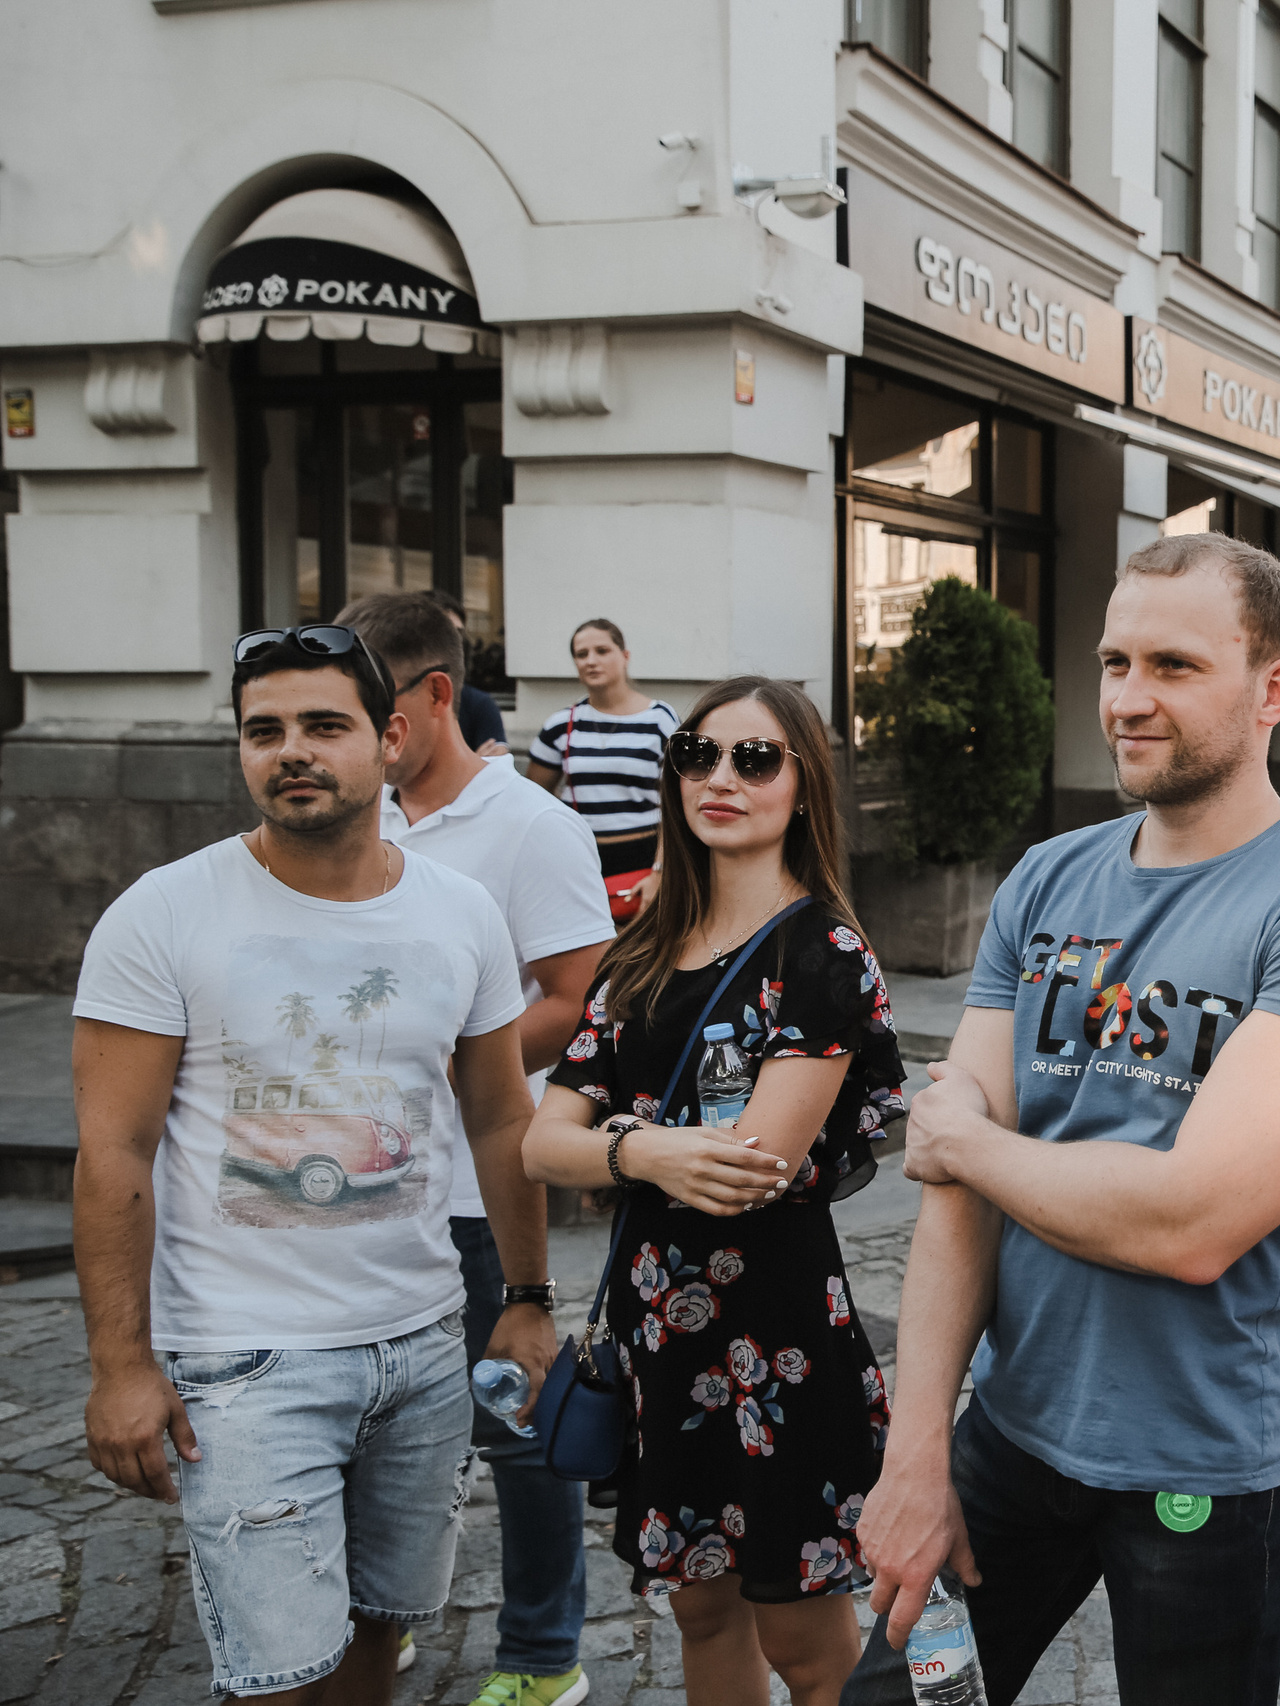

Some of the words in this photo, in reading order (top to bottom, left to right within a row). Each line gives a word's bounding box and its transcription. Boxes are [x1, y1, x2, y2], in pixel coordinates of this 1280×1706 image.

[294, 278, 456, 314] POKANY
[1020, 932, 1124, 990] GET
[1036, 971, 1244, 1078] LOST
[1031, 1060, 1047, 1074] OR
[1048, 1062, 1082, 1077] MEET
[1095, 1060, 1123, 1075] CITY
[1124, 1064, 1161, 1085] LIGHTS
